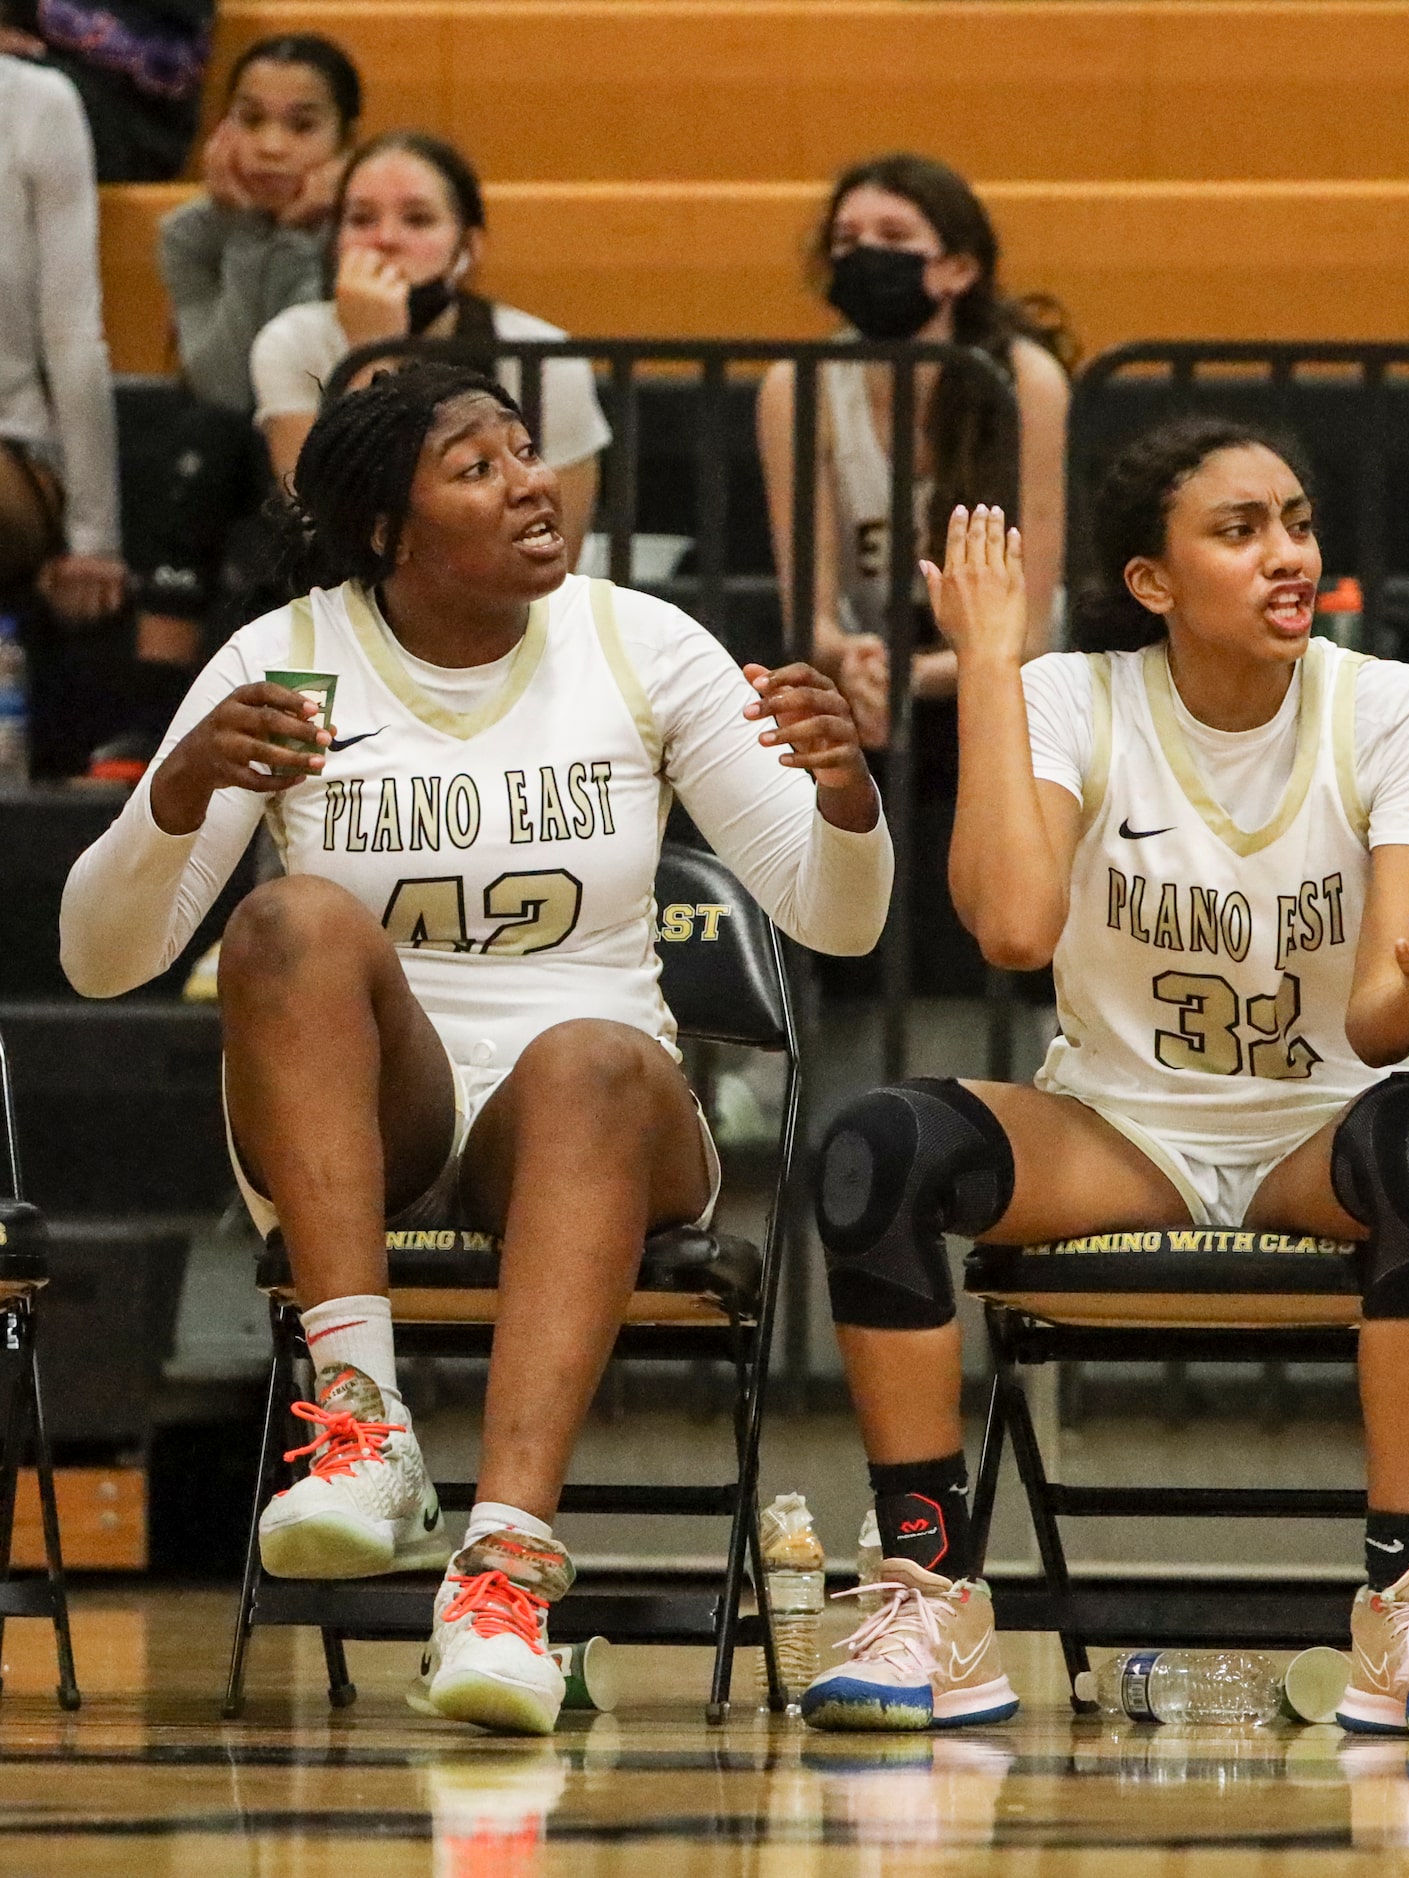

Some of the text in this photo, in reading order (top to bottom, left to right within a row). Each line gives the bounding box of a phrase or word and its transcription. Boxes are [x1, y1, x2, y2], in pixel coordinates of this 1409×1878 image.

[323, 761, 615, 852] PLANO EAST
[381, 868, 583, 956] 42
[655, 903, 732, 942] ST
[1107, 867, 1252, 963] PLANO
[1152, 970, 1324, 1080] 32
[1166, 1230, 1254, 1252] WITH
